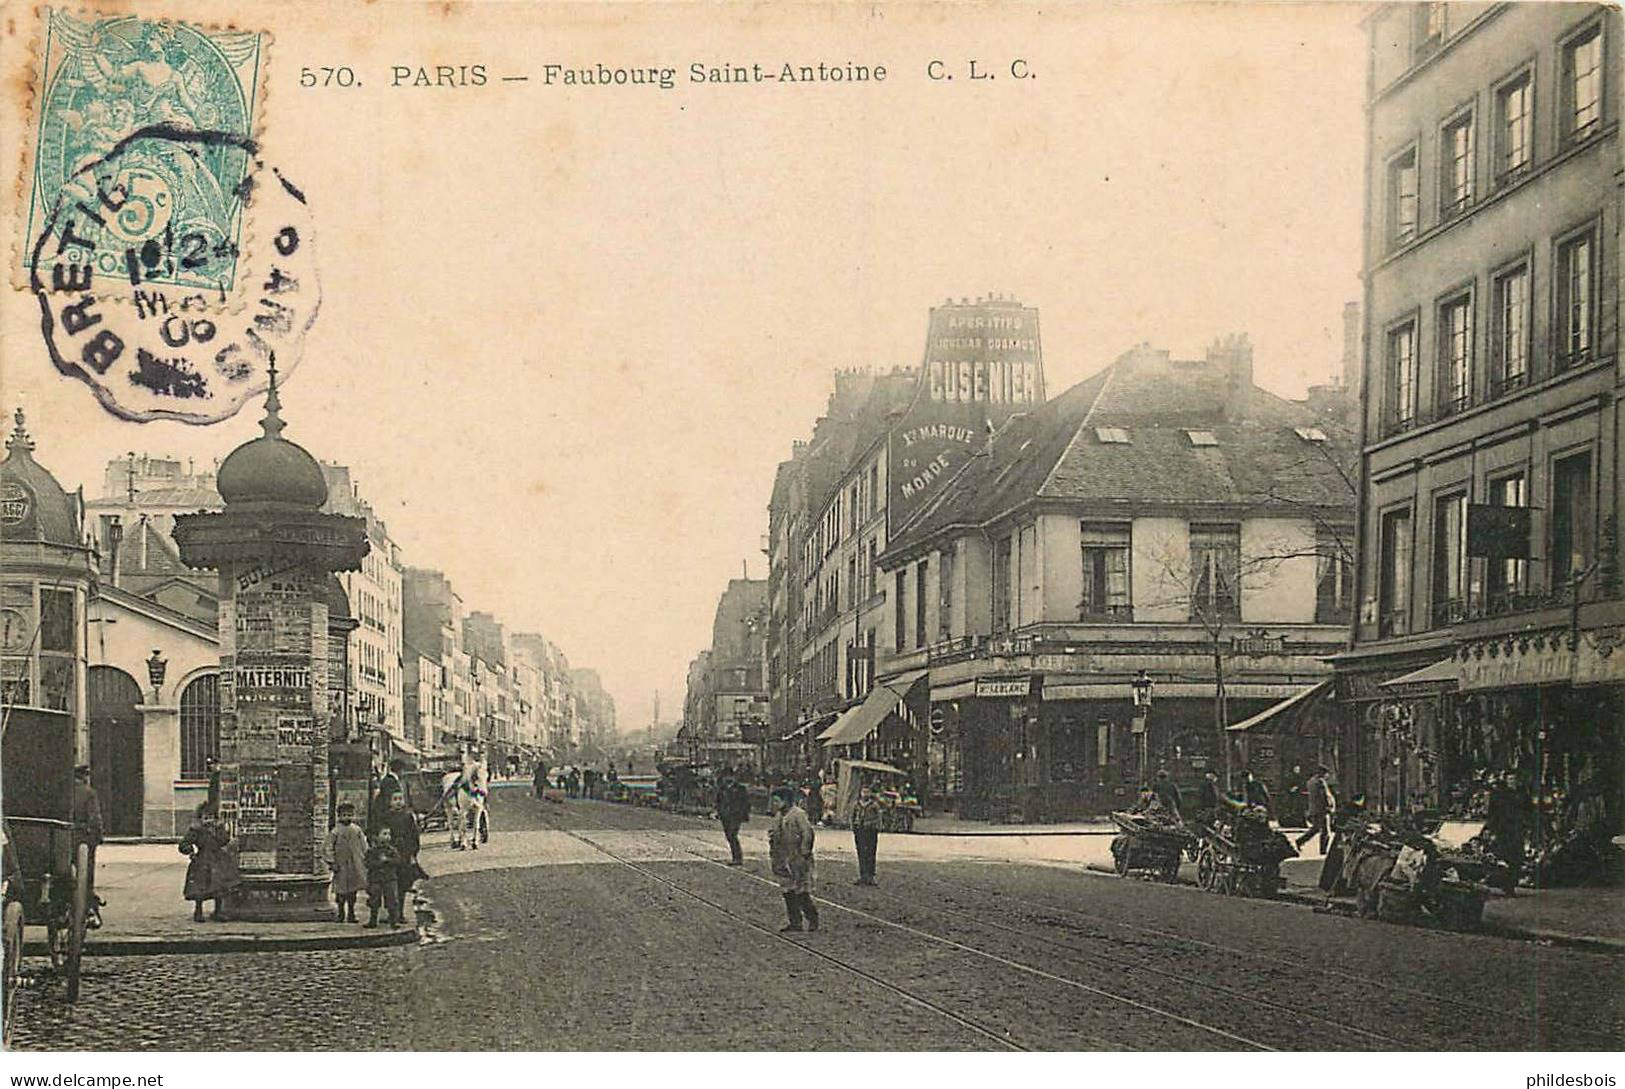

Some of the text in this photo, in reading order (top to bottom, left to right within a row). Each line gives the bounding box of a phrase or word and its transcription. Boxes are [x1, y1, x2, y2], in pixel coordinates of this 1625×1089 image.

[930, 361, 1035, 404] CUSENIER
[920, 424, 974, 444] MARQUE
[900, 453, 950, 499] MONDE
